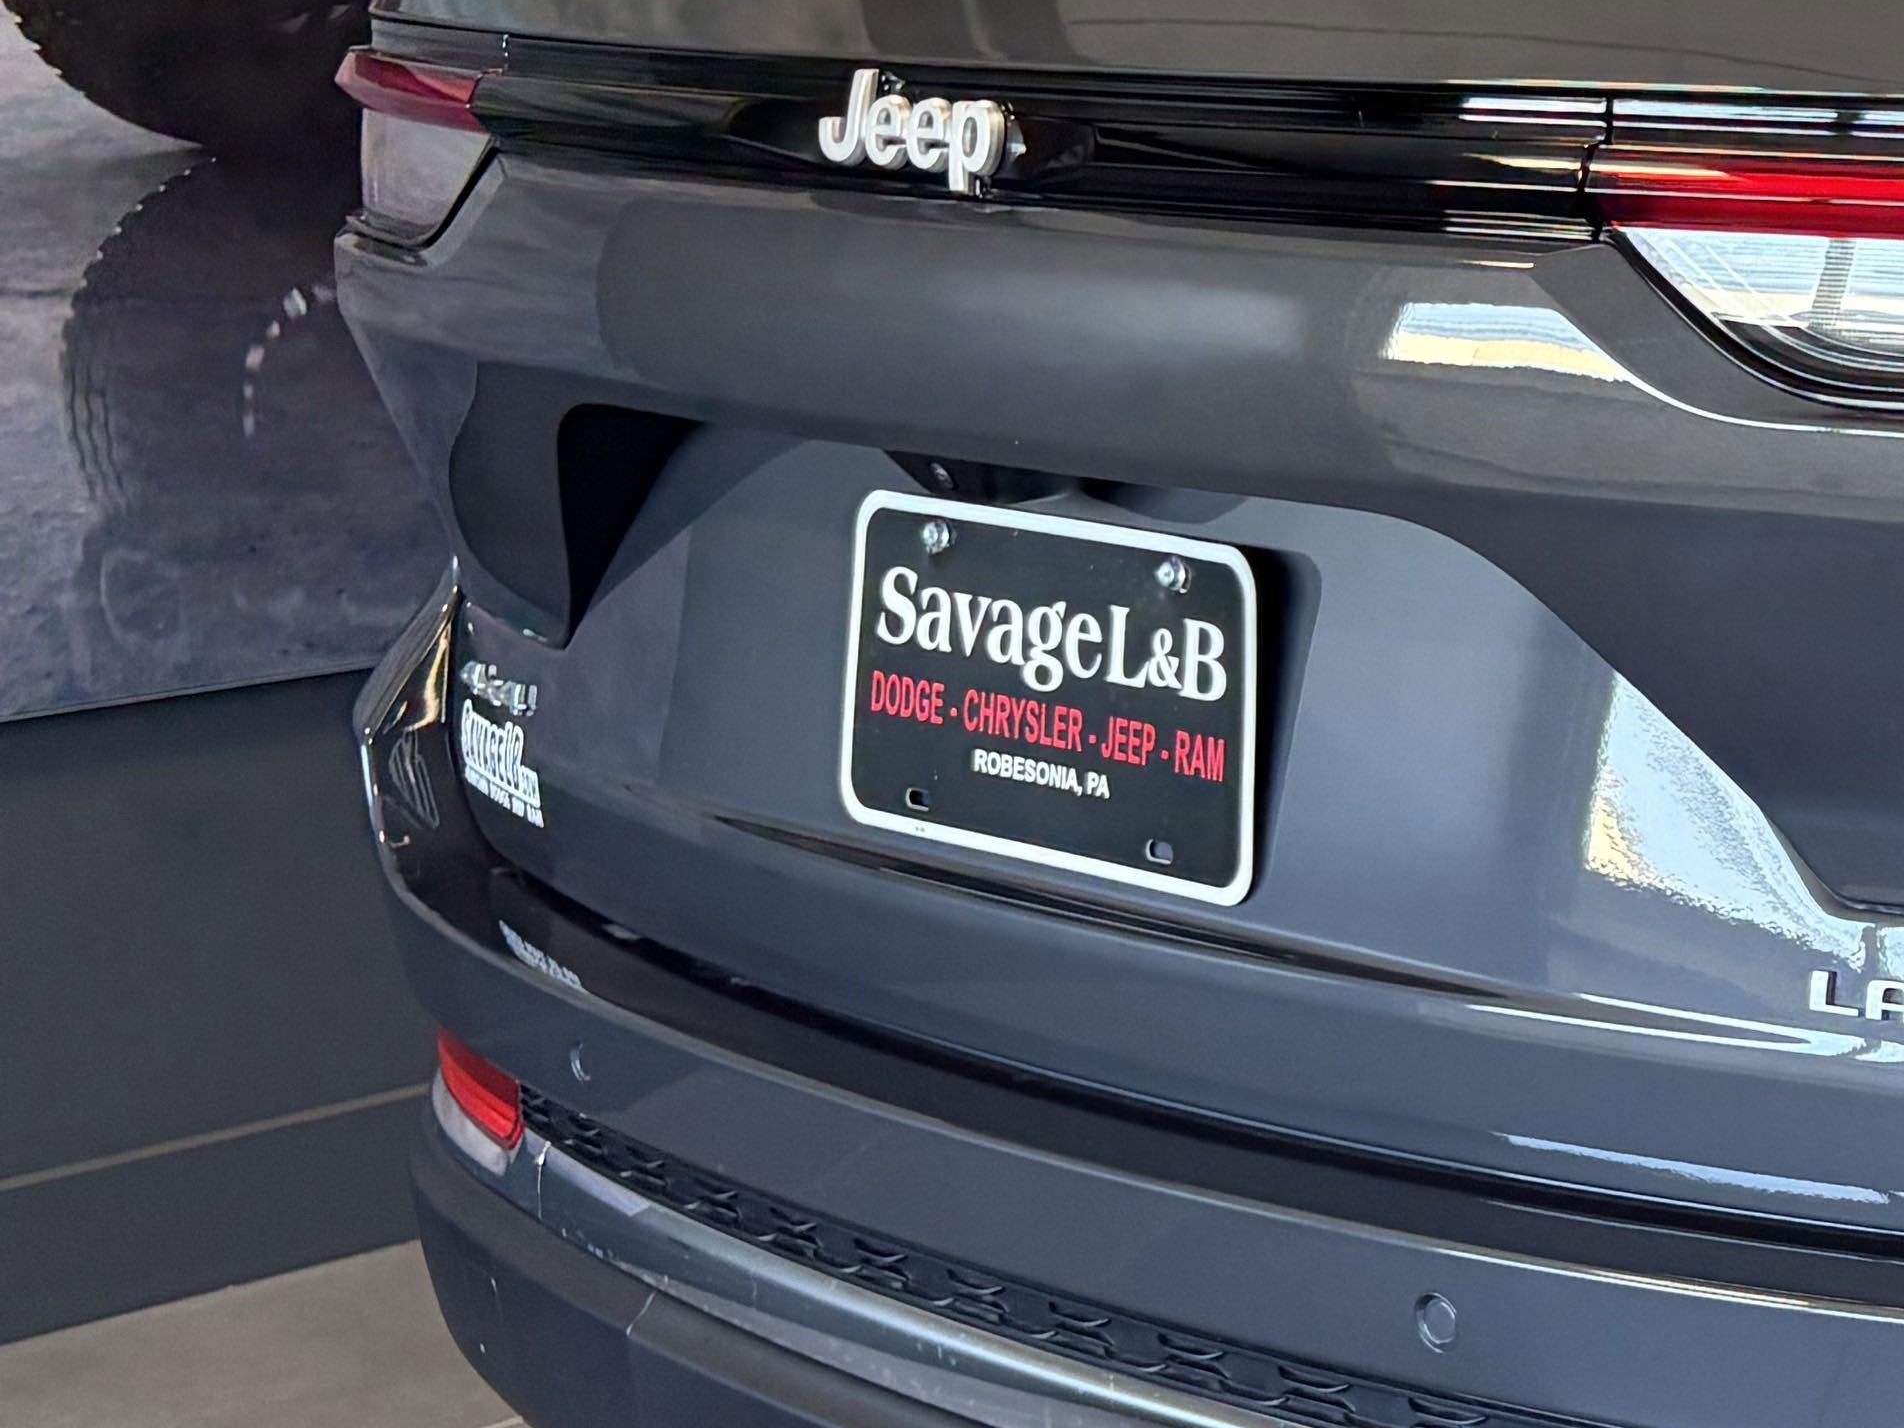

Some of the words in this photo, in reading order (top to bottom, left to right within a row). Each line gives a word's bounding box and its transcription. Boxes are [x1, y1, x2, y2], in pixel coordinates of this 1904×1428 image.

[818, 68, 1006, 194] Jeep
[871, 670, 945, 725] DODGE
[963, 688, 1084, 753] CHRYSLER
[1101, 715, 1156, 766] JEEP
[1174, 729, 1226, 783] RAM
[972, 748, 1084, 797] ROBESONIA,
[1086, 771, 1111, 799] PA
